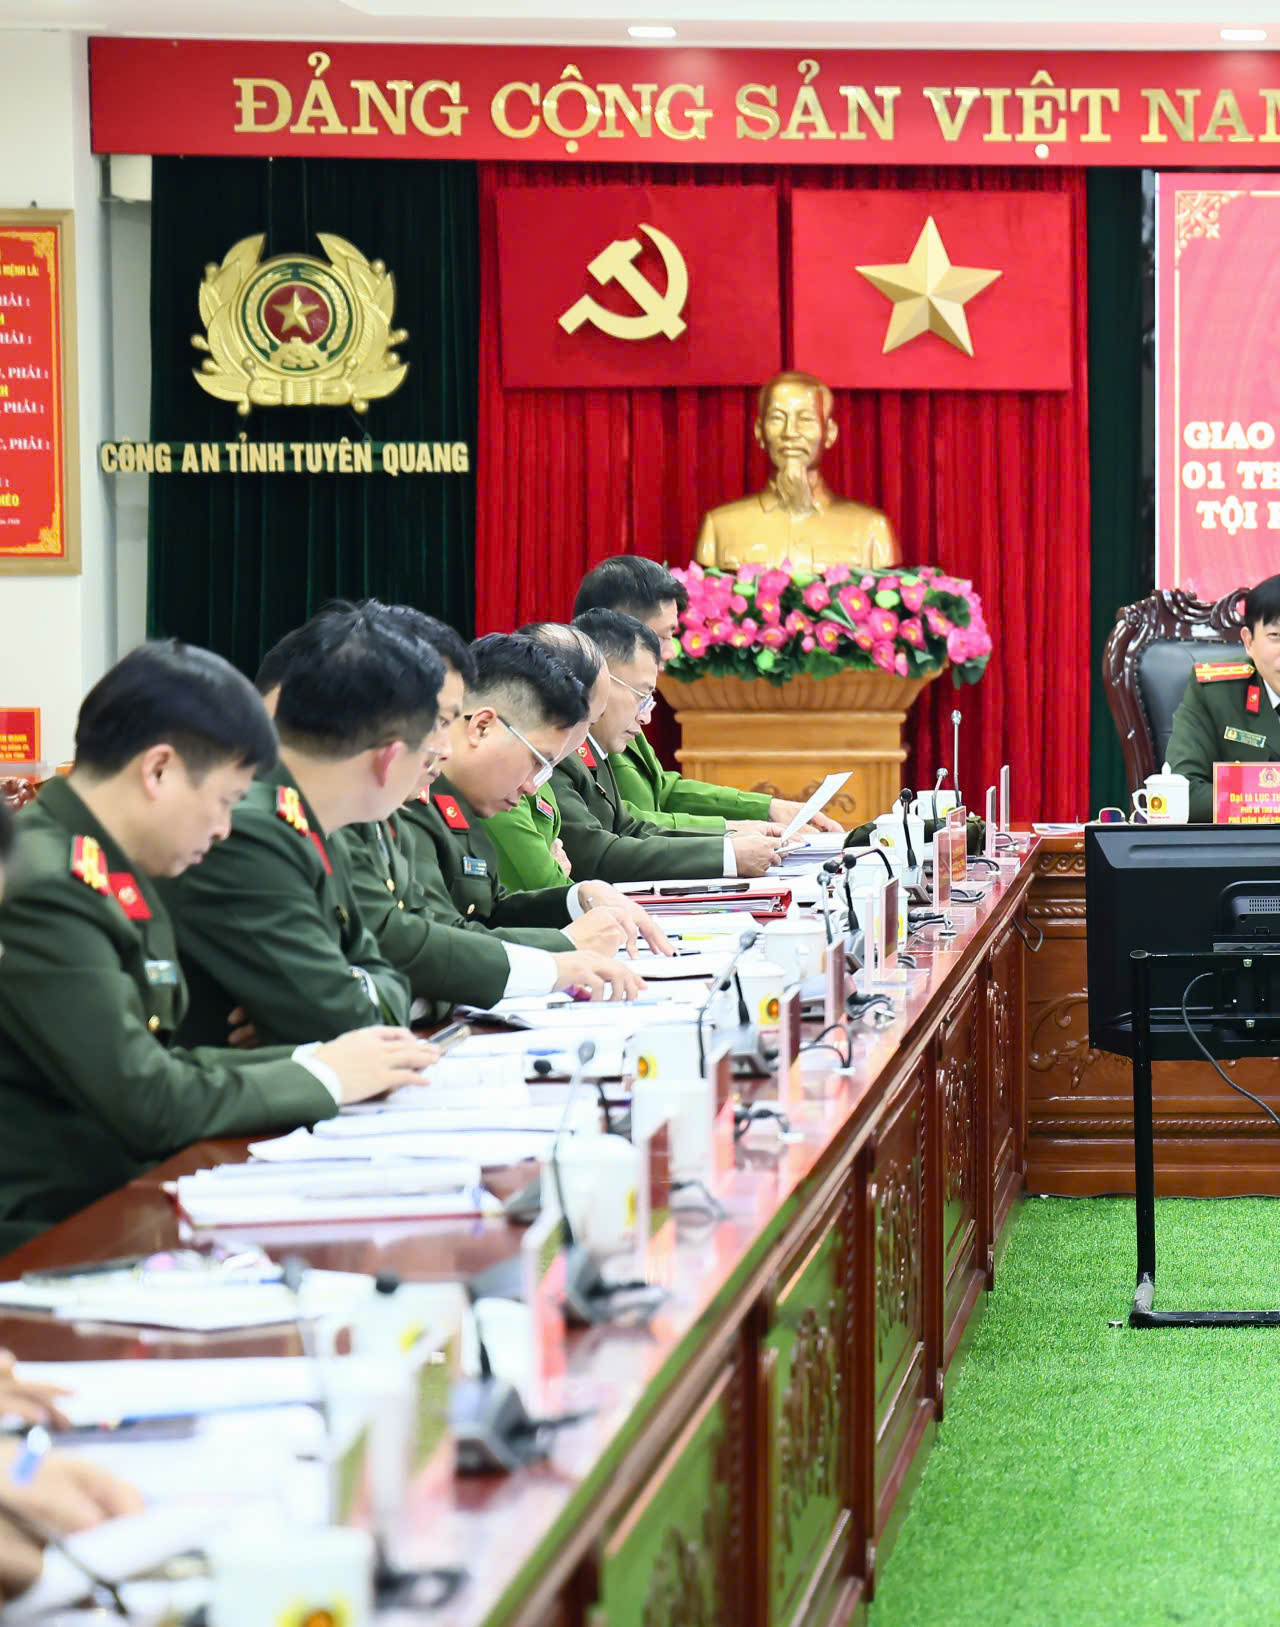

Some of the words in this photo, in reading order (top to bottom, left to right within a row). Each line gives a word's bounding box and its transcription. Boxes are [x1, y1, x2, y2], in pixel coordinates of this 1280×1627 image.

[233, 52, 469, 136] ĐẢNG
[491, 64, 714, 153] CỘNG
[736, 59, 902, 141] SẢN
[923, 70, 1120, 159] VIỆT
[102, 436, 171, 473] CÔNG
[182, 443, 220, 472] AN
[226, 433, 285, 472] TỈNH
[290, 437, 372, 472] TUYÊN
[383, 443, 468, 476] QUANG
[1184, 422, 1275, 449] GIAO
[1182, 461, 1225, 489] 01
[1196, 496, 1257, 534] TỘI
